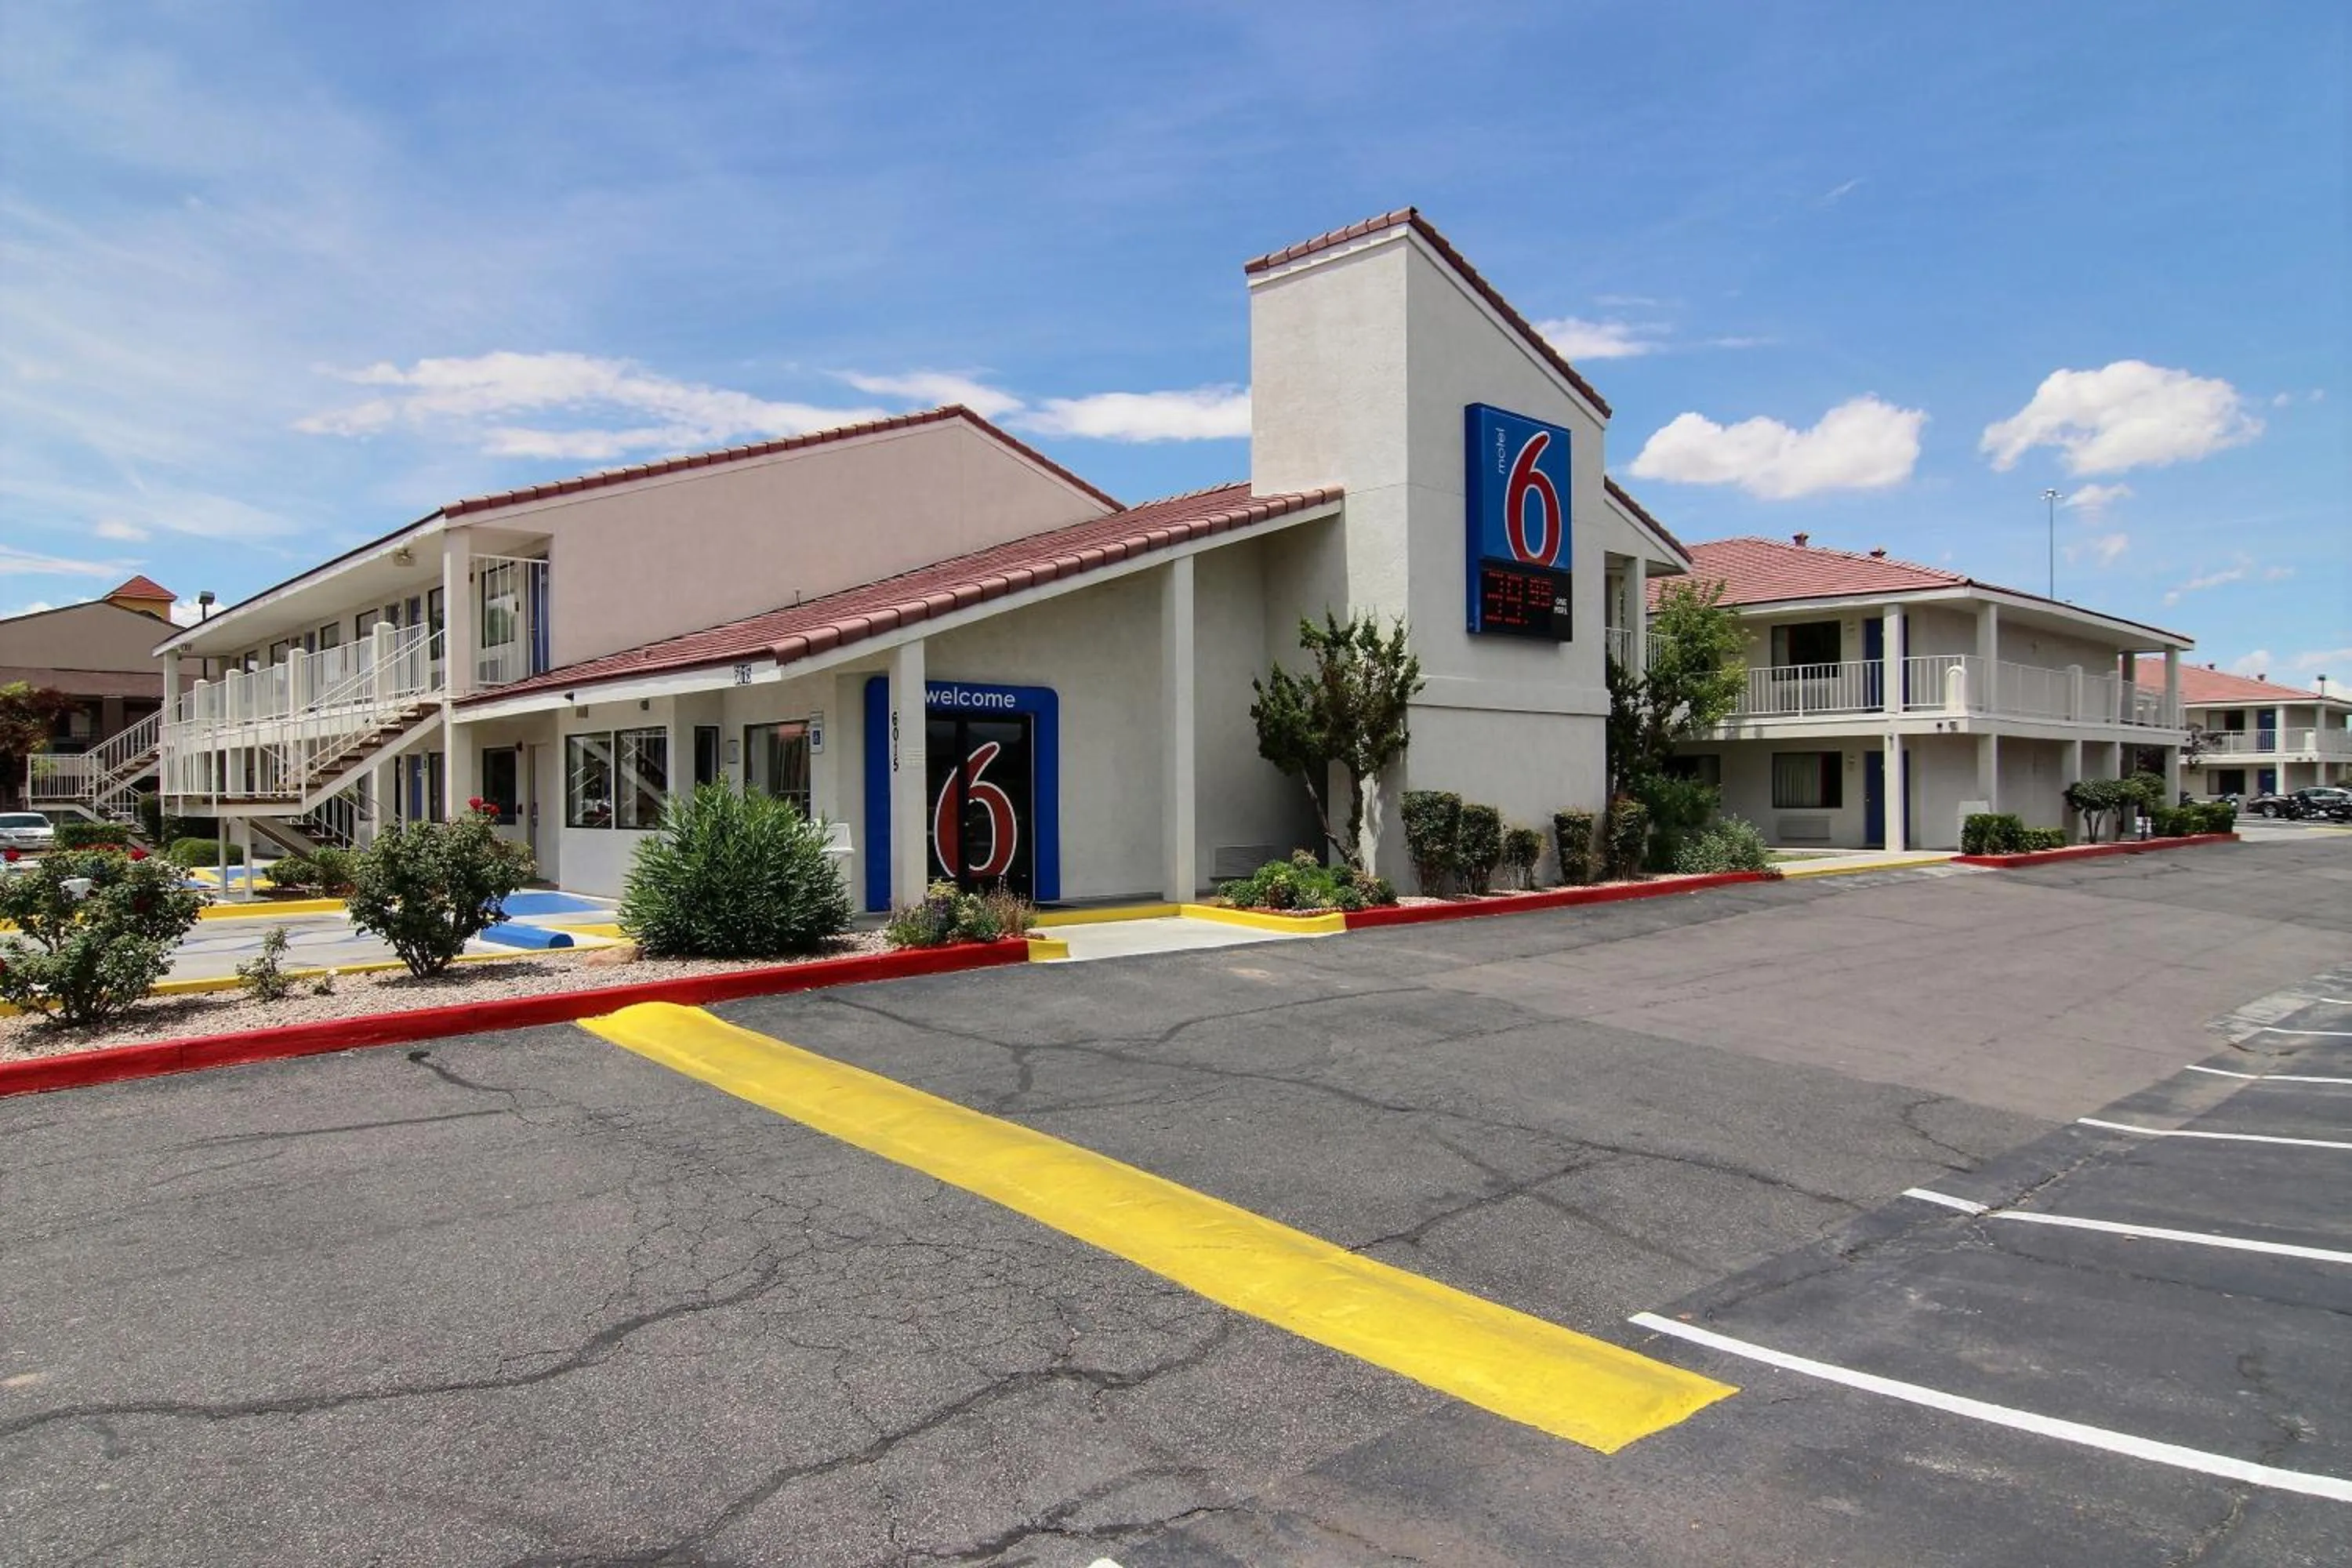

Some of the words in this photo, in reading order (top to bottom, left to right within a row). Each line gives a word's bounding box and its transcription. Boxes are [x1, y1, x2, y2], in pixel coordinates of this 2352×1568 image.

[1495, 427, 1506, 474] motel
[1504, 430, 1562, 567] 6
[924, 687, 1016, 708] welcome
[934, 741, 1018, 878] 6
